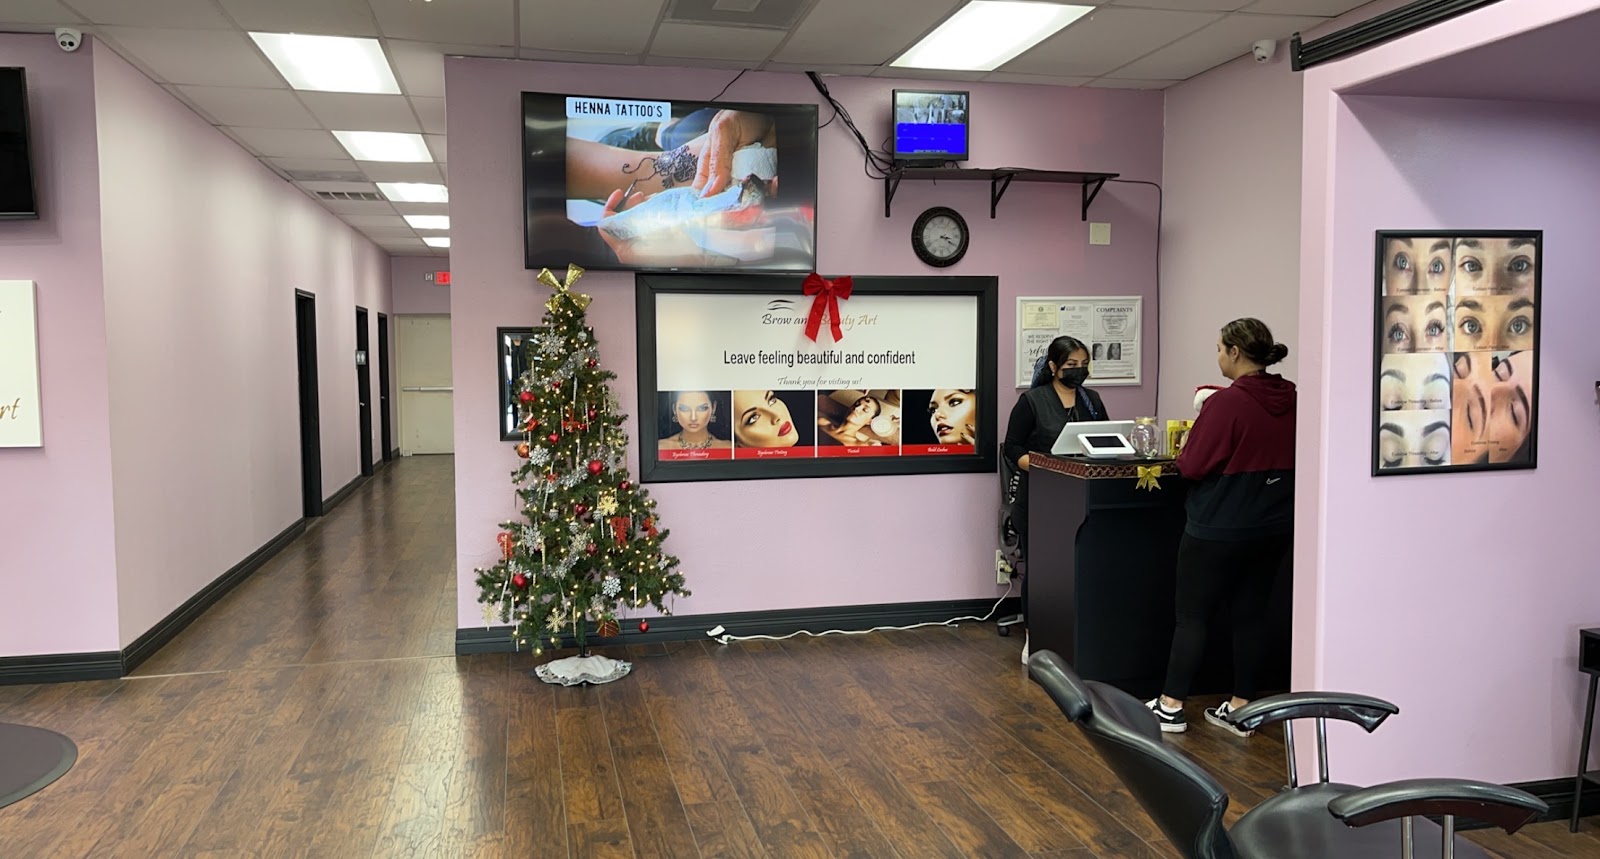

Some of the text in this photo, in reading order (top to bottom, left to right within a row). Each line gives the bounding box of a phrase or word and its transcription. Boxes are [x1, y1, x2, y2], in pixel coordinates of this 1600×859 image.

[575, 102, 663, 118] HENNA TATTOO'S
[762, 313, 792, 324] Brow
[858, 314, 878, 325] Art
[724, 350, 916, 367] Leave feeling beautiful and confident
[777, 376, 801, 386] Thank
[802, 379, 816, 389] you
[816, 376, 827, 387] for
[0, 397, 20, 420] rt
